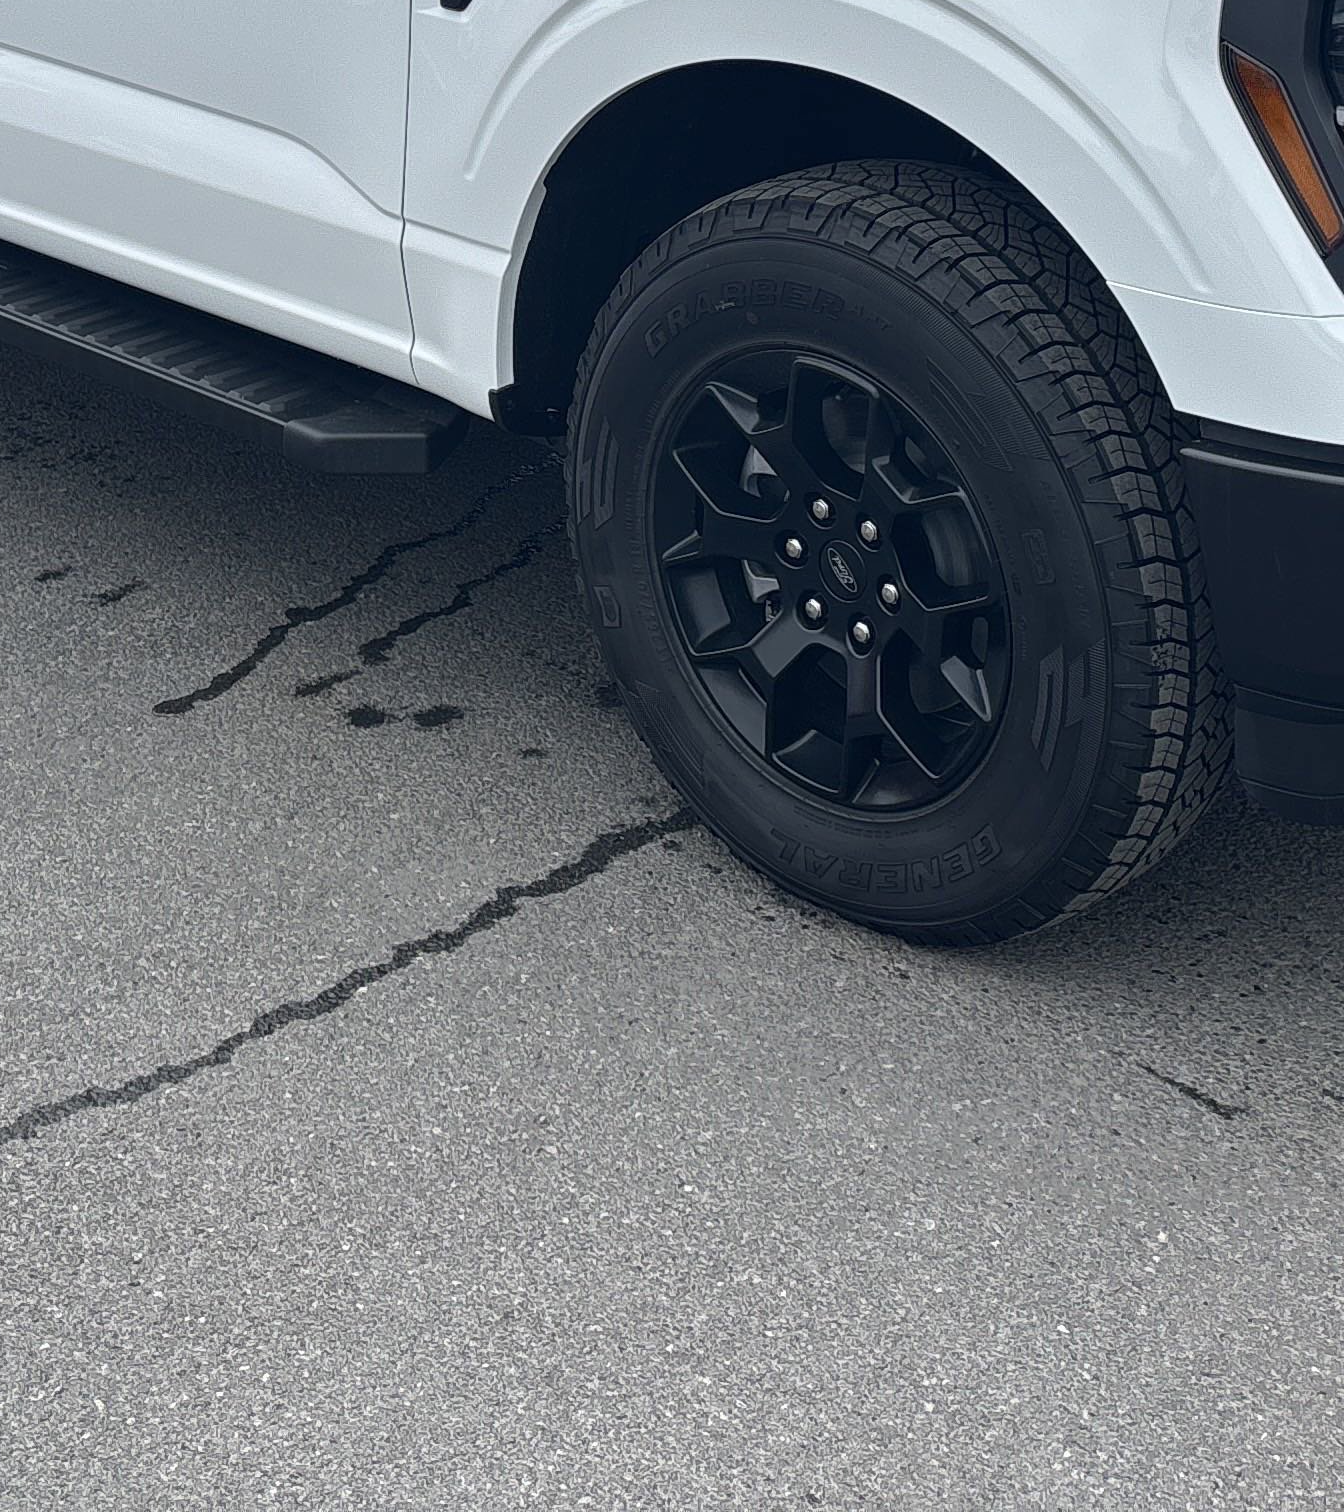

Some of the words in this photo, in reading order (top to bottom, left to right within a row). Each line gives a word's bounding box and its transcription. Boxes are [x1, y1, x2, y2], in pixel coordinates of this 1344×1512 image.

[642, 277, 845, 360] GRABBER
[831, 554, 855, 585] Ford
[768, 822, 1004, 894] GENERAL
